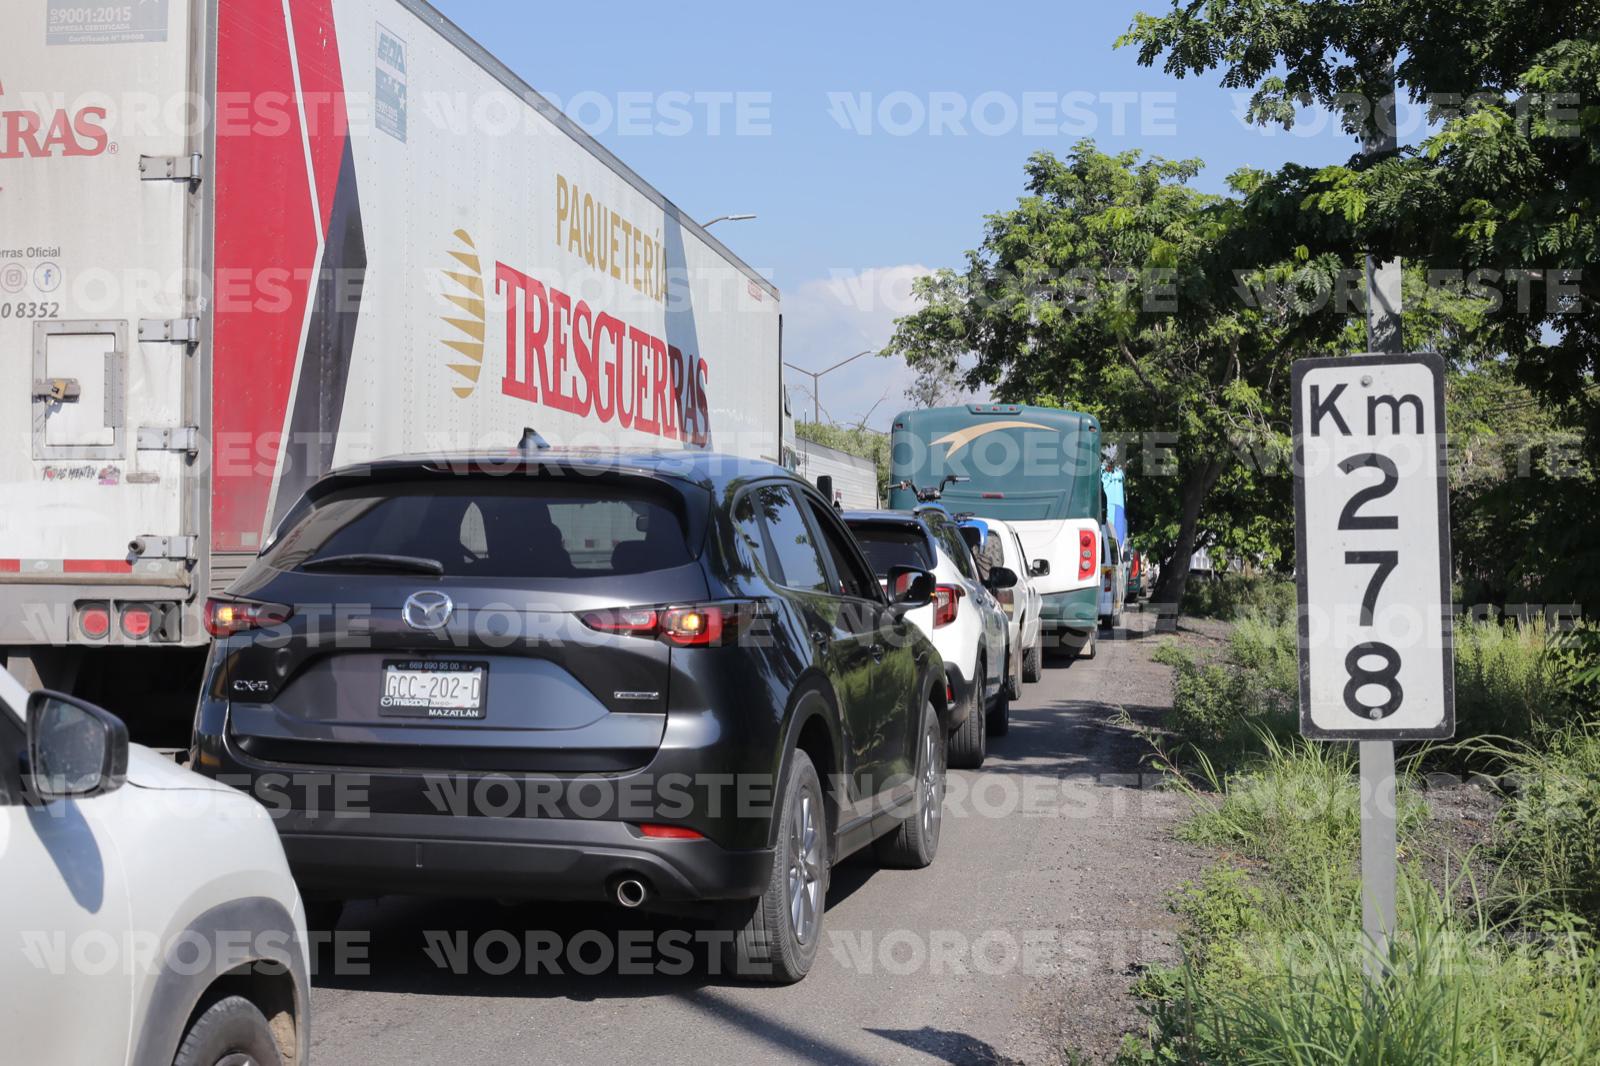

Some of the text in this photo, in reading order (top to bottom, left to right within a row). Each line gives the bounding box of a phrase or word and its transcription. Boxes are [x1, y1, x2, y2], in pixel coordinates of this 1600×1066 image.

[59, 6, 132, 23] 9001:2015
[0, 106, 108, 159] RAS
[556, 173, 669, 306] PAQUETERÍA
[0, 246, 61, 258] rras Oficial
[15, 302, 60, 318] 8352
[495, 260, 709, 448] TRESGUERRAS
[1310, 383, 1425, 437] Km
[233, 680, 269, 691] CX-5
[428, 709, 479, 718] MAZATLÁN
